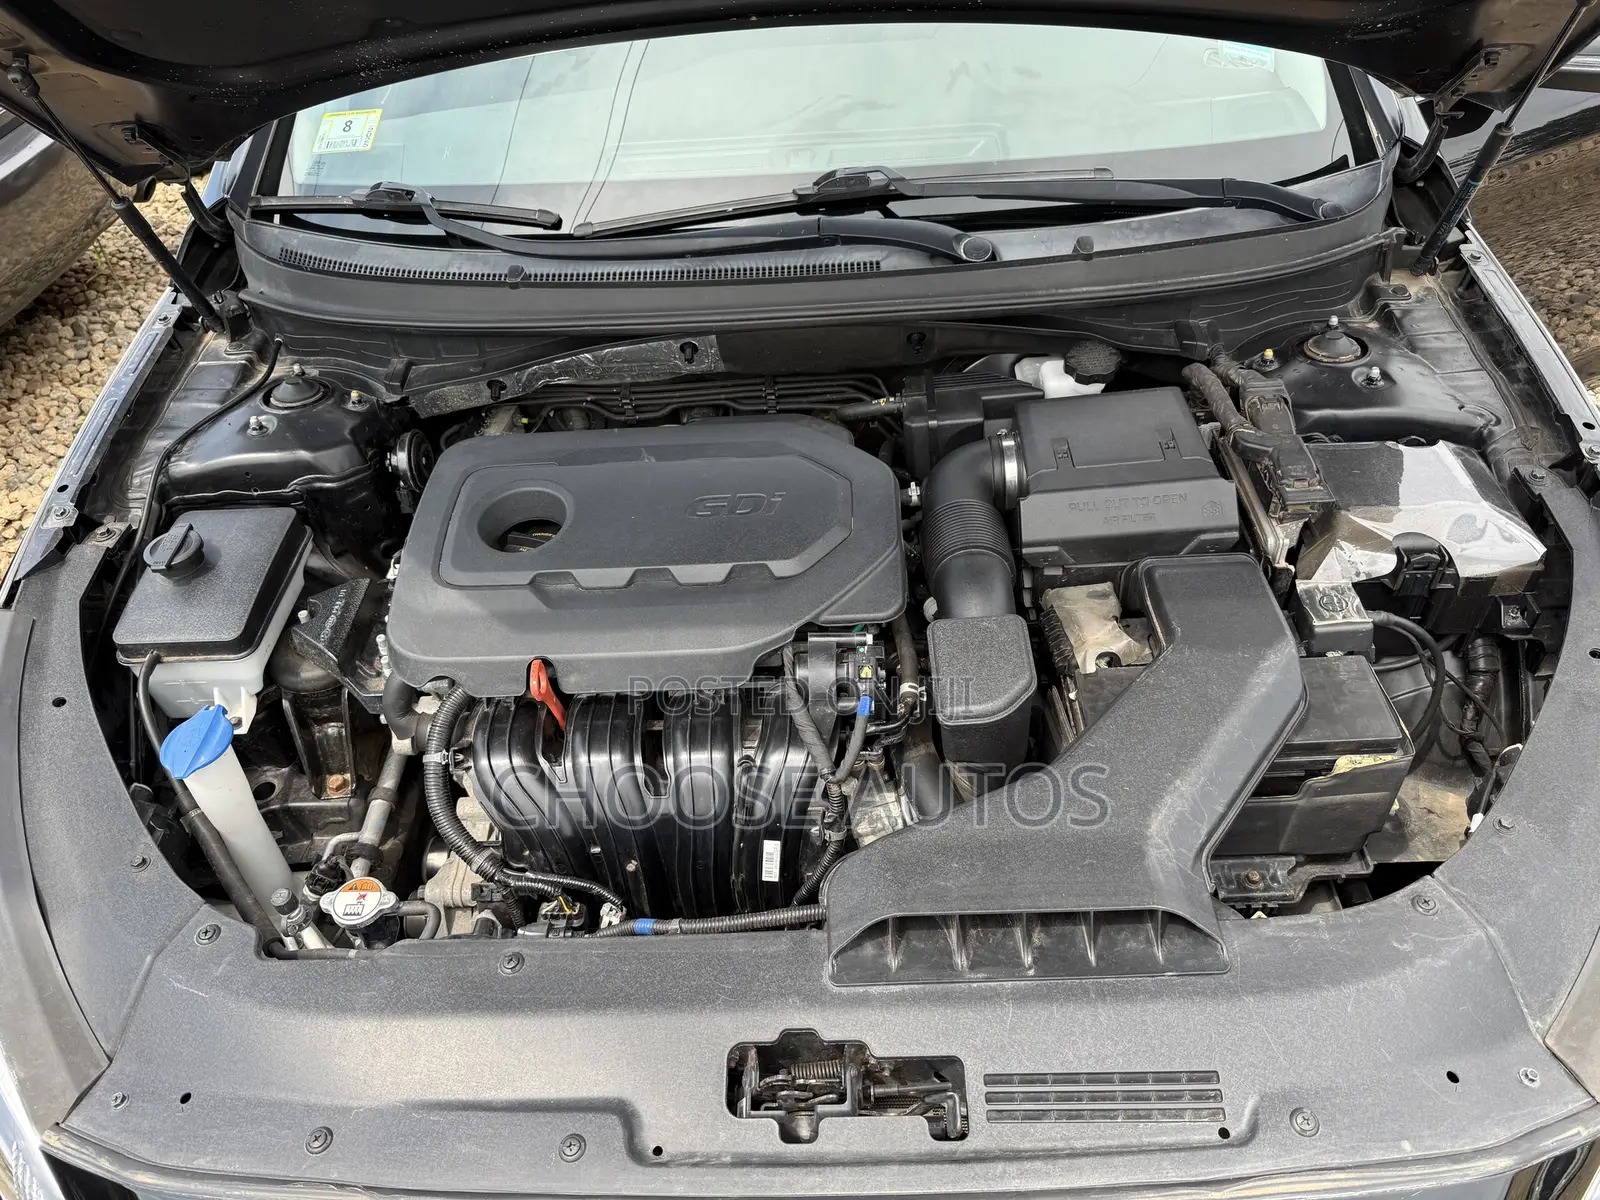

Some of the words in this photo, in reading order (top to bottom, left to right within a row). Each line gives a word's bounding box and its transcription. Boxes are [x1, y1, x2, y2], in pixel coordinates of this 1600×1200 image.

[342, 119, 353, 133] 8
[1068, 500, 1100, 514] PULL
[1153, 492, 1188, 506] OPEN
[1122, 512, 1156, 524] FILTER
